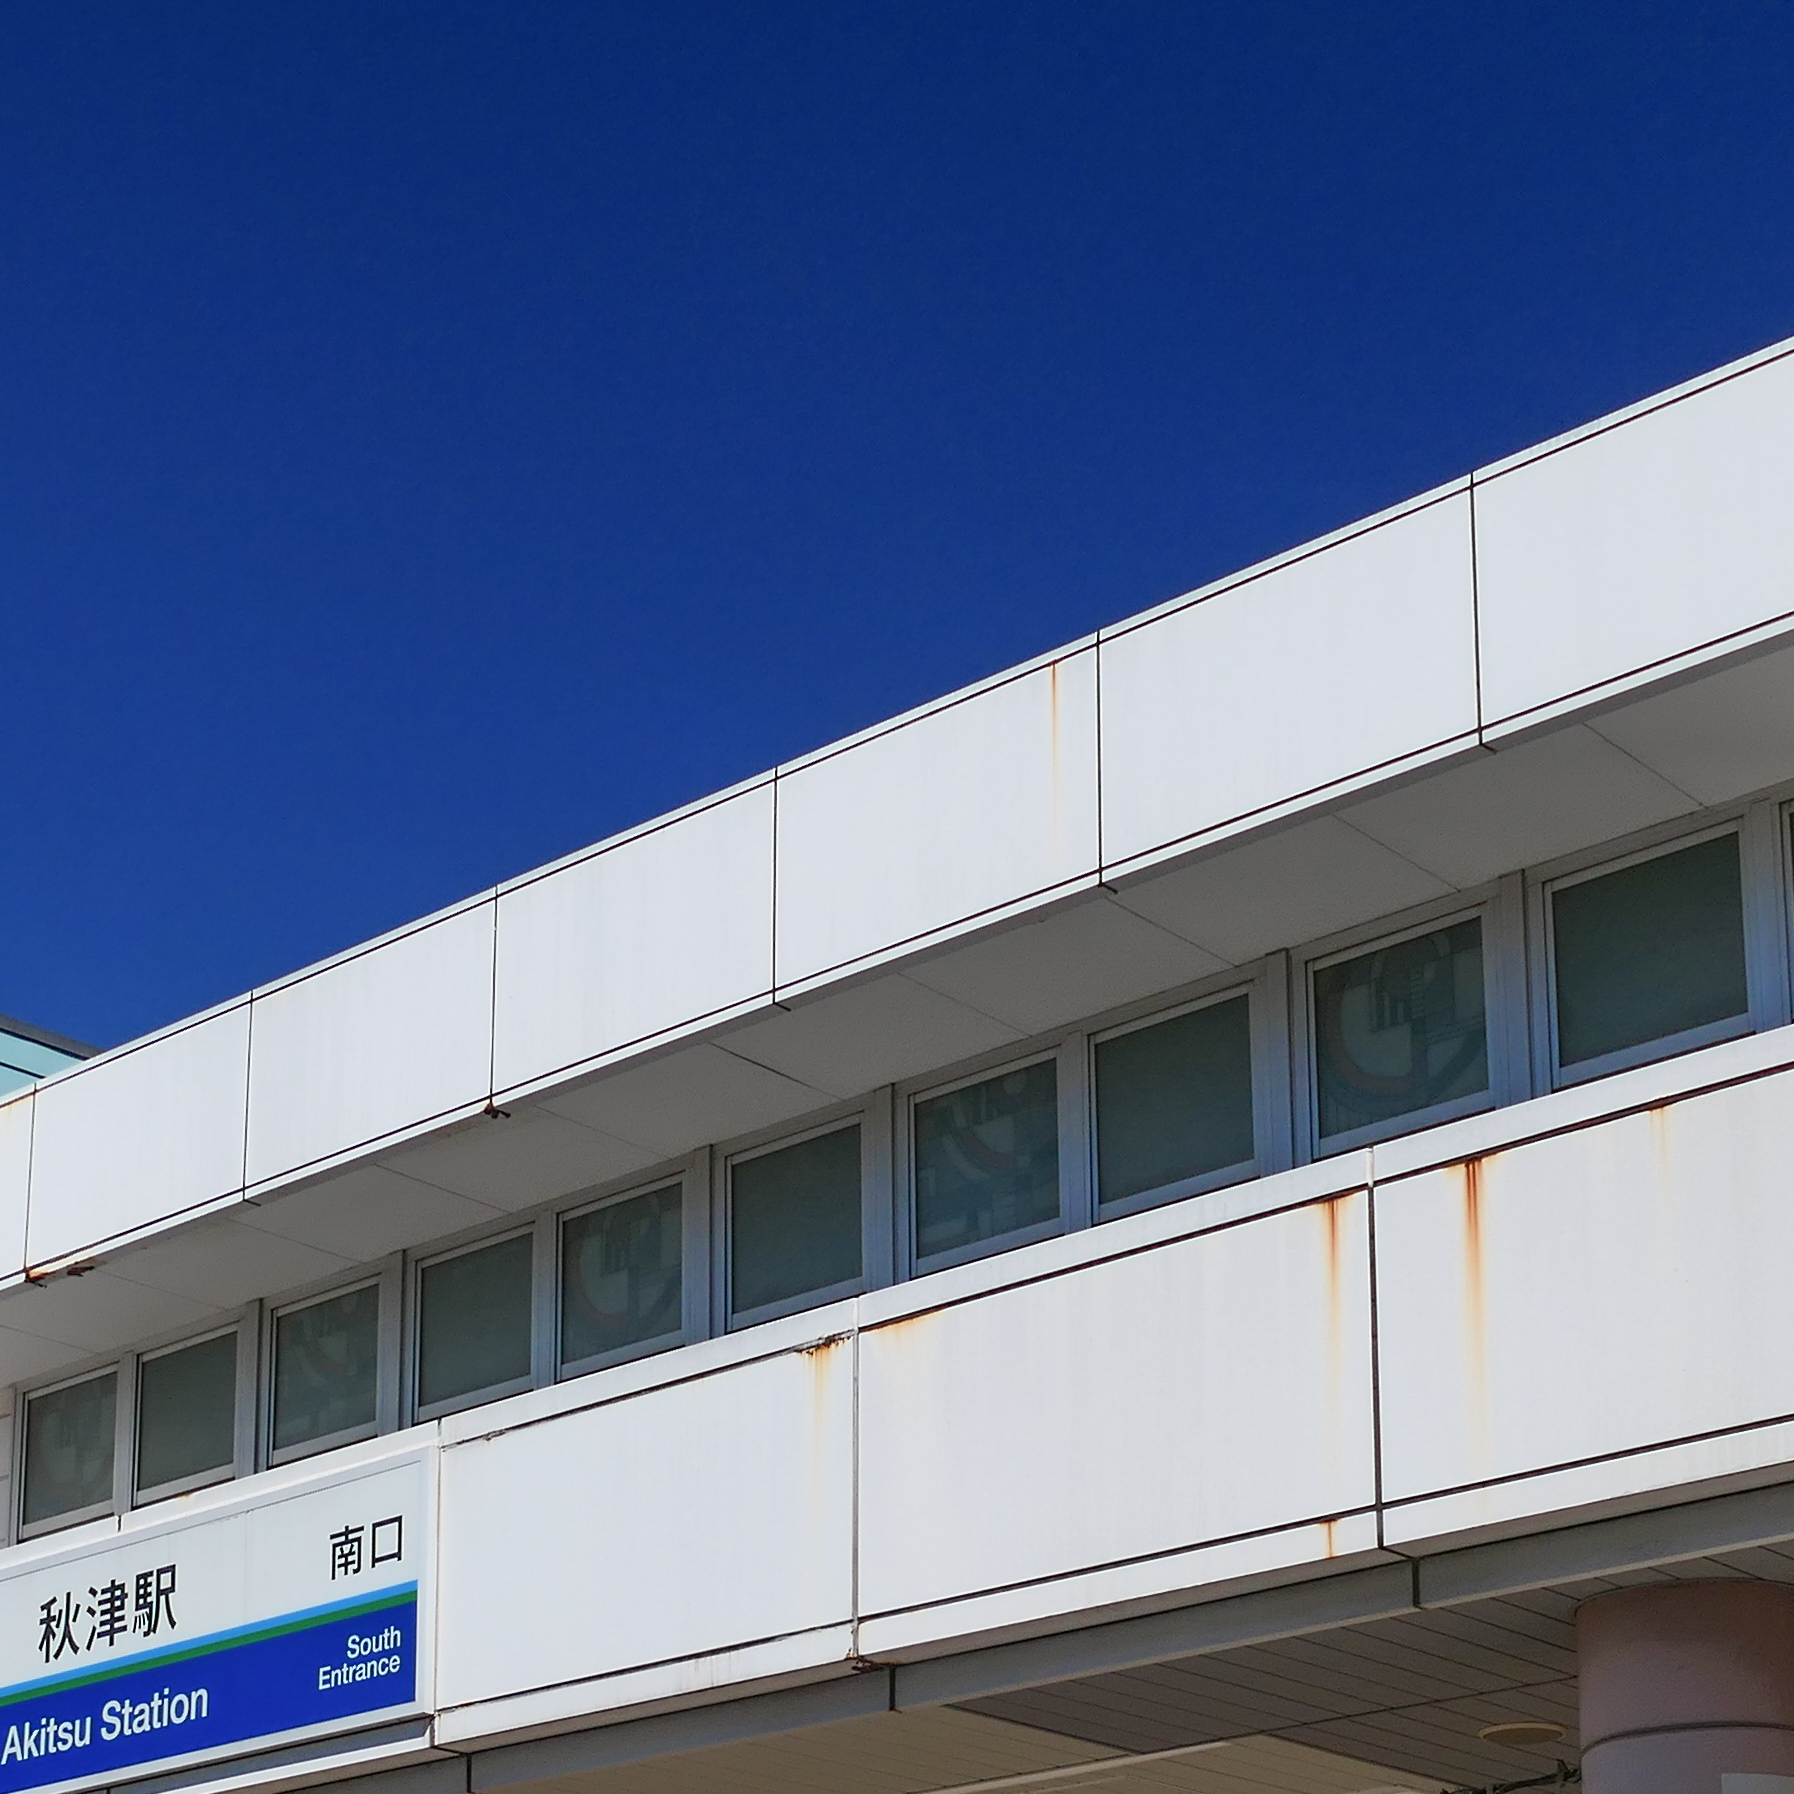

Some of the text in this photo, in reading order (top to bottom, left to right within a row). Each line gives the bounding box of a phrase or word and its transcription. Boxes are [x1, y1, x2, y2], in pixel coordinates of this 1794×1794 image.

[328, 1514, 404, 1581] 南口
[37, 1564, 178, 1664] 秋津駅
[345, 1625, 402, 1660] South
[317, 1652, 402, 1692] Entrance
[0, 1687, 209, 1766] Akitsu Station
